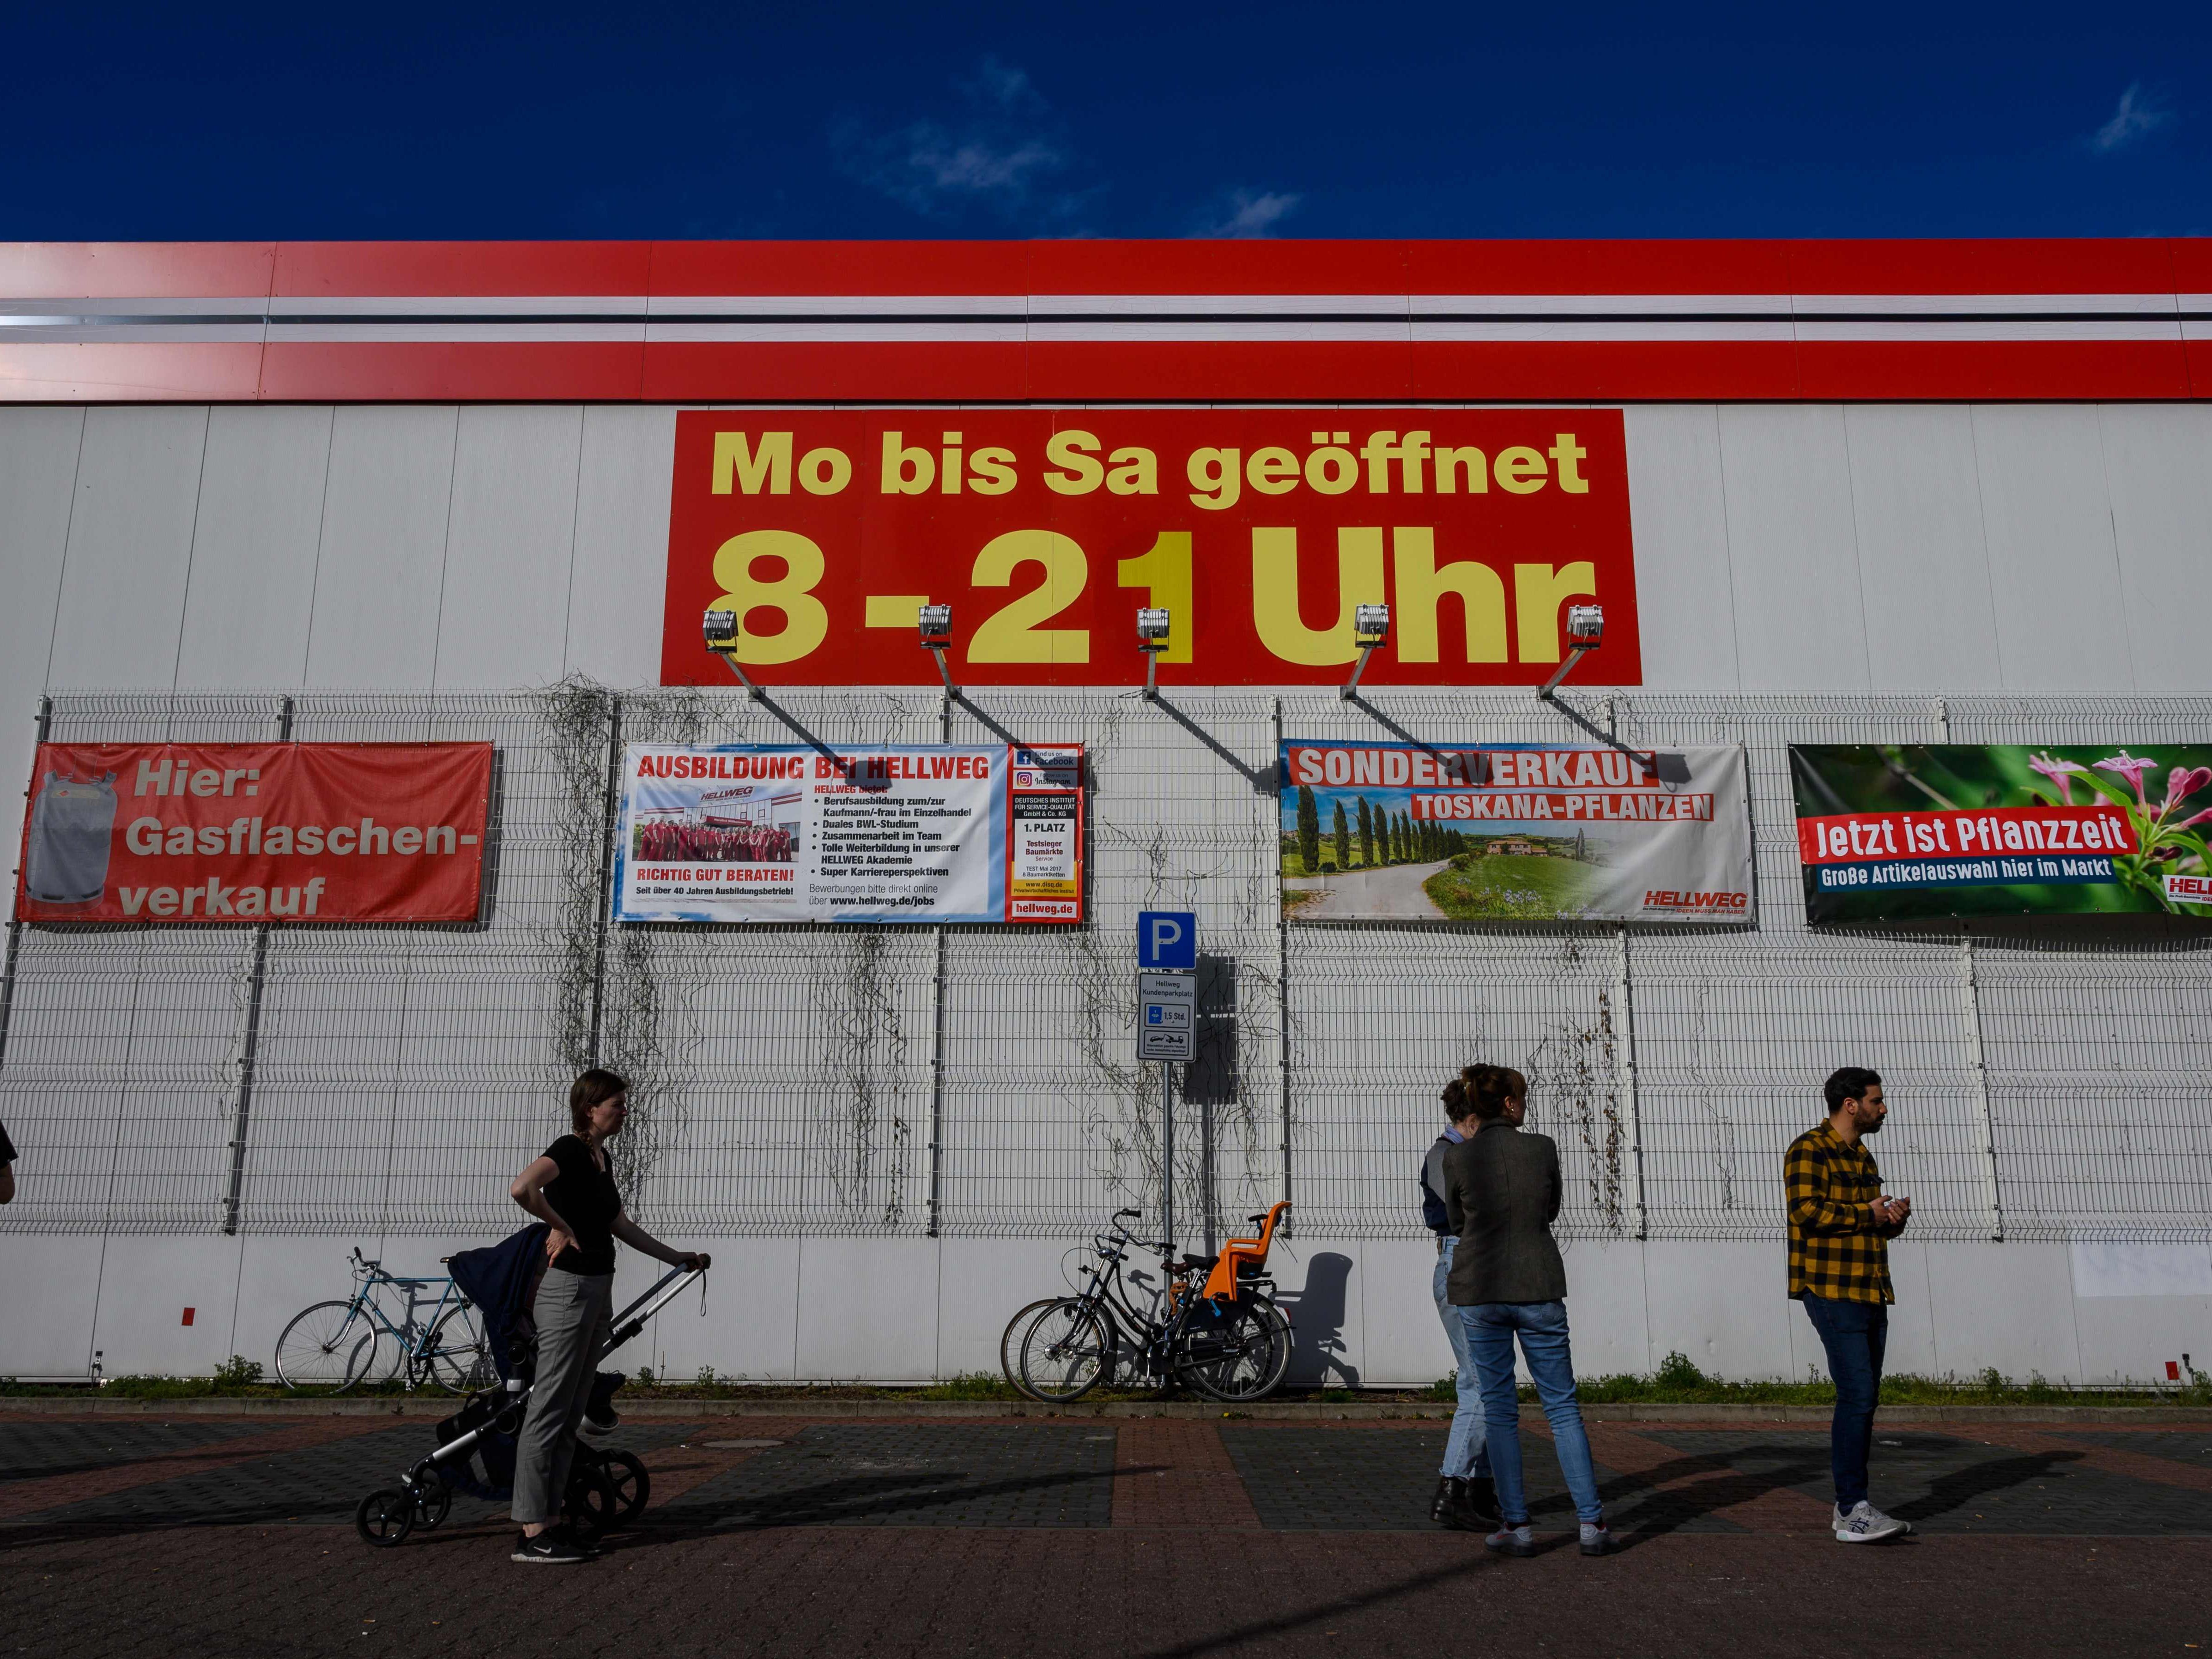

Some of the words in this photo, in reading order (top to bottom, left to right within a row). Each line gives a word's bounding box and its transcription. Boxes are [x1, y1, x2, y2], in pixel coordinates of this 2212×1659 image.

[712, 432, 852, 495] Mo
[881, 431, 1018, 495] bis
[1043, 430, 1159, 495] Sa
[1188, 431, 1588, 510] geöffnet
[1252, 527, 1596, 666] Uhr
[637, 756, 804, 779] AUSBILDUNG
[815, 757, 856, 779] BEI
[868, 757, 988, 779] HELLWEG
[1298, 750, 1657, 786] SONDERVERKAUF
[134, 759, 260, 796] Hier:
[1035, 777, 1071, 787] Instagram
[701, 786, 753, 800] HELLWEG
[814, 785, 856, 793] HELLWEG
[859, 785, 888, 793] bietet:
[824, 797, 904, 806] Berufsausbildung
[907, 797, 945, 805] zum/zur
[824, 808, 896, 817] Kaufmann/-frau
[899, 808, 911, 817] im
[914, 808, 971, 817] Einzelhandel
[1416, 794, 1710, 821] TOSKANA-PFLANZEN
[823, 820, 854, 828] Duales
[856, 820, 919, 828] BWL-Studium
[1024, 823, 1032, 832] 1.
[1034, 823, 1065, 832] PLATZ
[126, 817, 478, 855] Gasflaschen-
[822, 831, 900, 840] Zusammenarbeit
[903, 831, 914, 840] im
[917, 832, 942, 840] Team
[1818, 819, 1897, 858] Jetzt
[1903, 816, 1951, 853] ist
[1956, 813, 2128, 851] Pflanzzeit
[822, 843, 843, 852] Tolle
[846, 843, 910, 854] Weiterbildung
[913, 844, 921, 852] in
[821, 855, 863, 864] HELLWEG
[866, 856, 913, 864] Akademie
[637, 868, 691, 881] RICHTIG
[696, 869, 722, 881] GUT
[726, 869, 794, 881] BERATEN!
[820, 867, 848, 878] Super
[851, 867, 949, 878] Karriereperspektiven
[1822, 867, 1868, 886] Große
[1872, 860, 1997, 883] Artikelauswahl
[2002, 860, 2034, 878] hier
[2038, 858, 2059, 877] im
[2064, 857, 2112, 877] Markt
[636, 886, 651, 895] Seit
[653, 886, 672, 895] über
[715, 887, 794, 896] Ausbildungsbetrieb!
[809, 884, 865, 894] Bewerbungen
[868, 884, 886, 893] bitte
[888, 884, 911, 893] direkt
[914, 884, 938, 893] online
[118, 877, 326, 916] verkauf
[809, 896, 827, 905] über
[830, 896, 935, 907] www.hellweg.de/jobs
[1644, 890, 1748, 908] HELLWEG
[1016, 903, 1073, 914] hellweg.de
[1152, 919, 1182, 960] P
[1156, 980, 1180, 989] Hellweg
[1142, 989, 1193, 997] Kundenparkplatz
[1174, 1012, 1186, 1020] Std.
